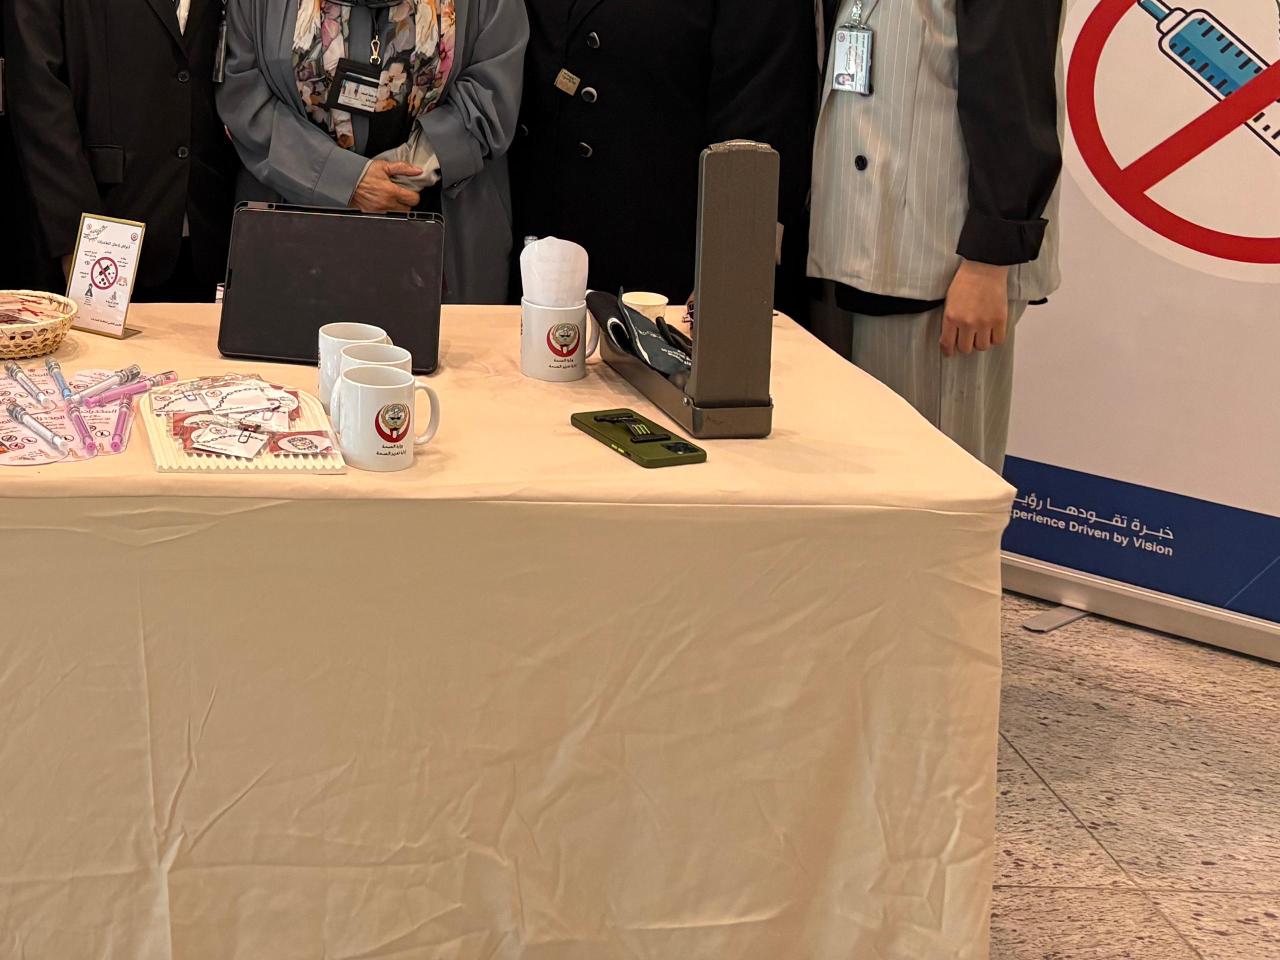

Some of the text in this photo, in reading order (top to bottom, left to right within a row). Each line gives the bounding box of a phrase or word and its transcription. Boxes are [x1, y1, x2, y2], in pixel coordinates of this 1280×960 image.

[1014, 493, 1043, 510] رؤي
[1010, 508, 1173, 556] perience Driven by Vision
[1131, 519, 1174, 540] خبرة
